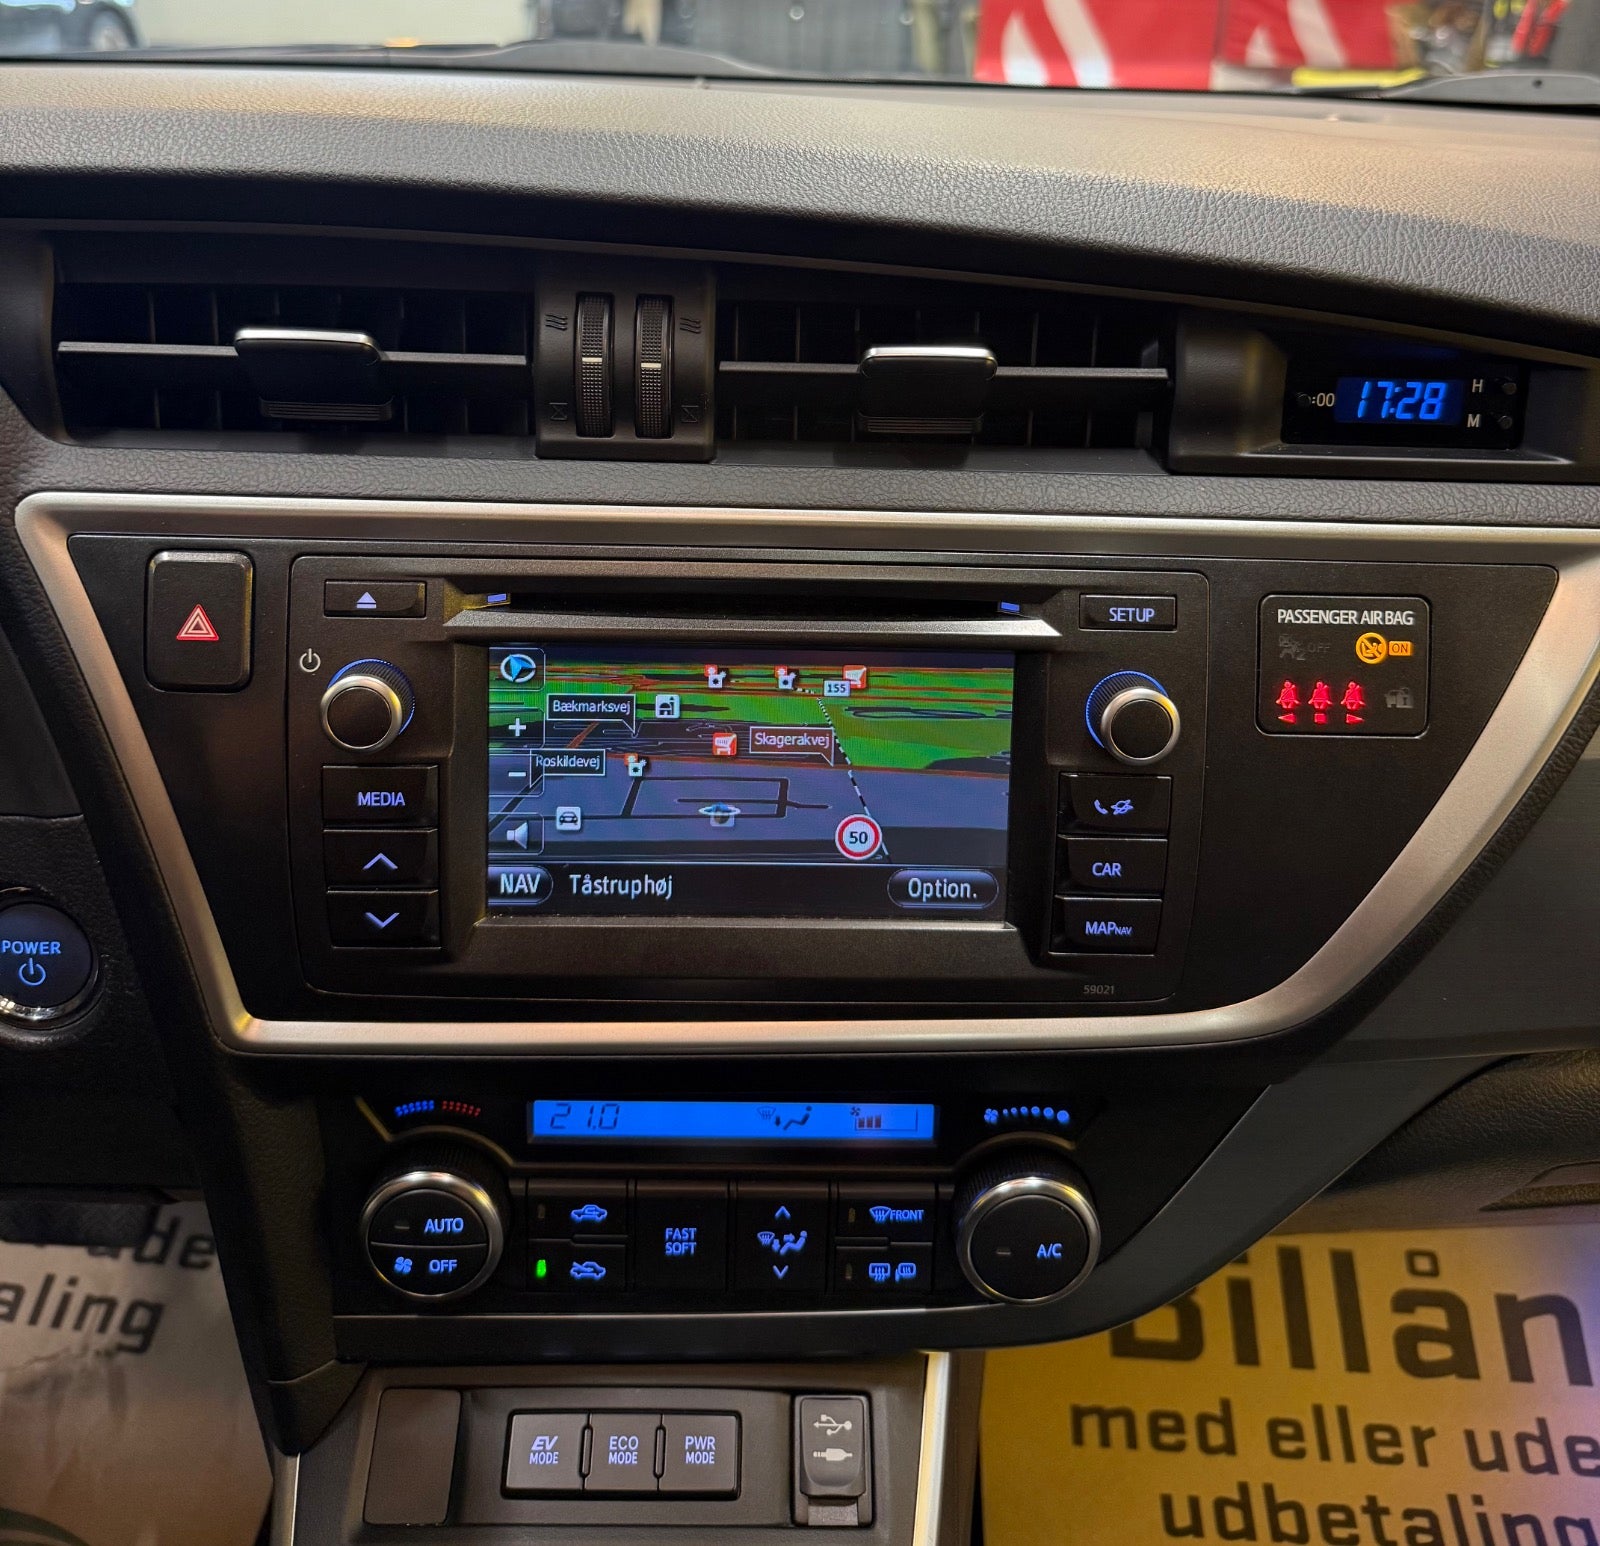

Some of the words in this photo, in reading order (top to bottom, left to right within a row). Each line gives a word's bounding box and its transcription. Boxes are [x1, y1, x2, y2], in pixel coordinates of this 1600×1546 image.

[1471, 378, 1484, 394] H
[1357, 381, 1448, 420] 17:28
[1466, 413, 1481, 429] M
[1109, 606, 1156, 624] SETUP
[1277, 608, 1357, 625] PASSENGER
[1391, 642, 1409, 654] ON
[826, 681, 847, 695] 155
[552, 698, 631, 716] Bækmarksvej
[754, 730, 831, 749] Skagerakvej
[357, 791, 406, 808] MEDIA
[848, 829, 869, 847] 50
[1091, 861, 1122, 878] CAR
[500, 874, 540, 895] NAV
[569, 873, 673, 900] Tåstruphøj
[907, 875, 978, 900] Option.
[2, 940, 61, 954] POWER
[1083, 984, 1115, 996] 59021
[550, 1102, 620, 1130] 21.0
[889, 1209, 924, 1222] FRONT
[424, 1218, 464, 1234] AUTO
[665, 1228, 697, 1242] FAST
[665, 1242, 697, 1256] SOFT
[1036, 1243, 1063, 1259] A/C
[429, 1259, 458, 1274] OFF
[1070, 1398, 1236, 1456] med
[1266, 1403, 1436, 1467] eller
[531, 1435, 558, 1451] EV
[609, 1435, 639, 1451] ECO
[685, 1435, 716, 1451] PWR
[529, 1451, 559, 1464] MODE
[608, 1451, 638, 1465] MODE
[685, 1450, 715, 1465] MODE
